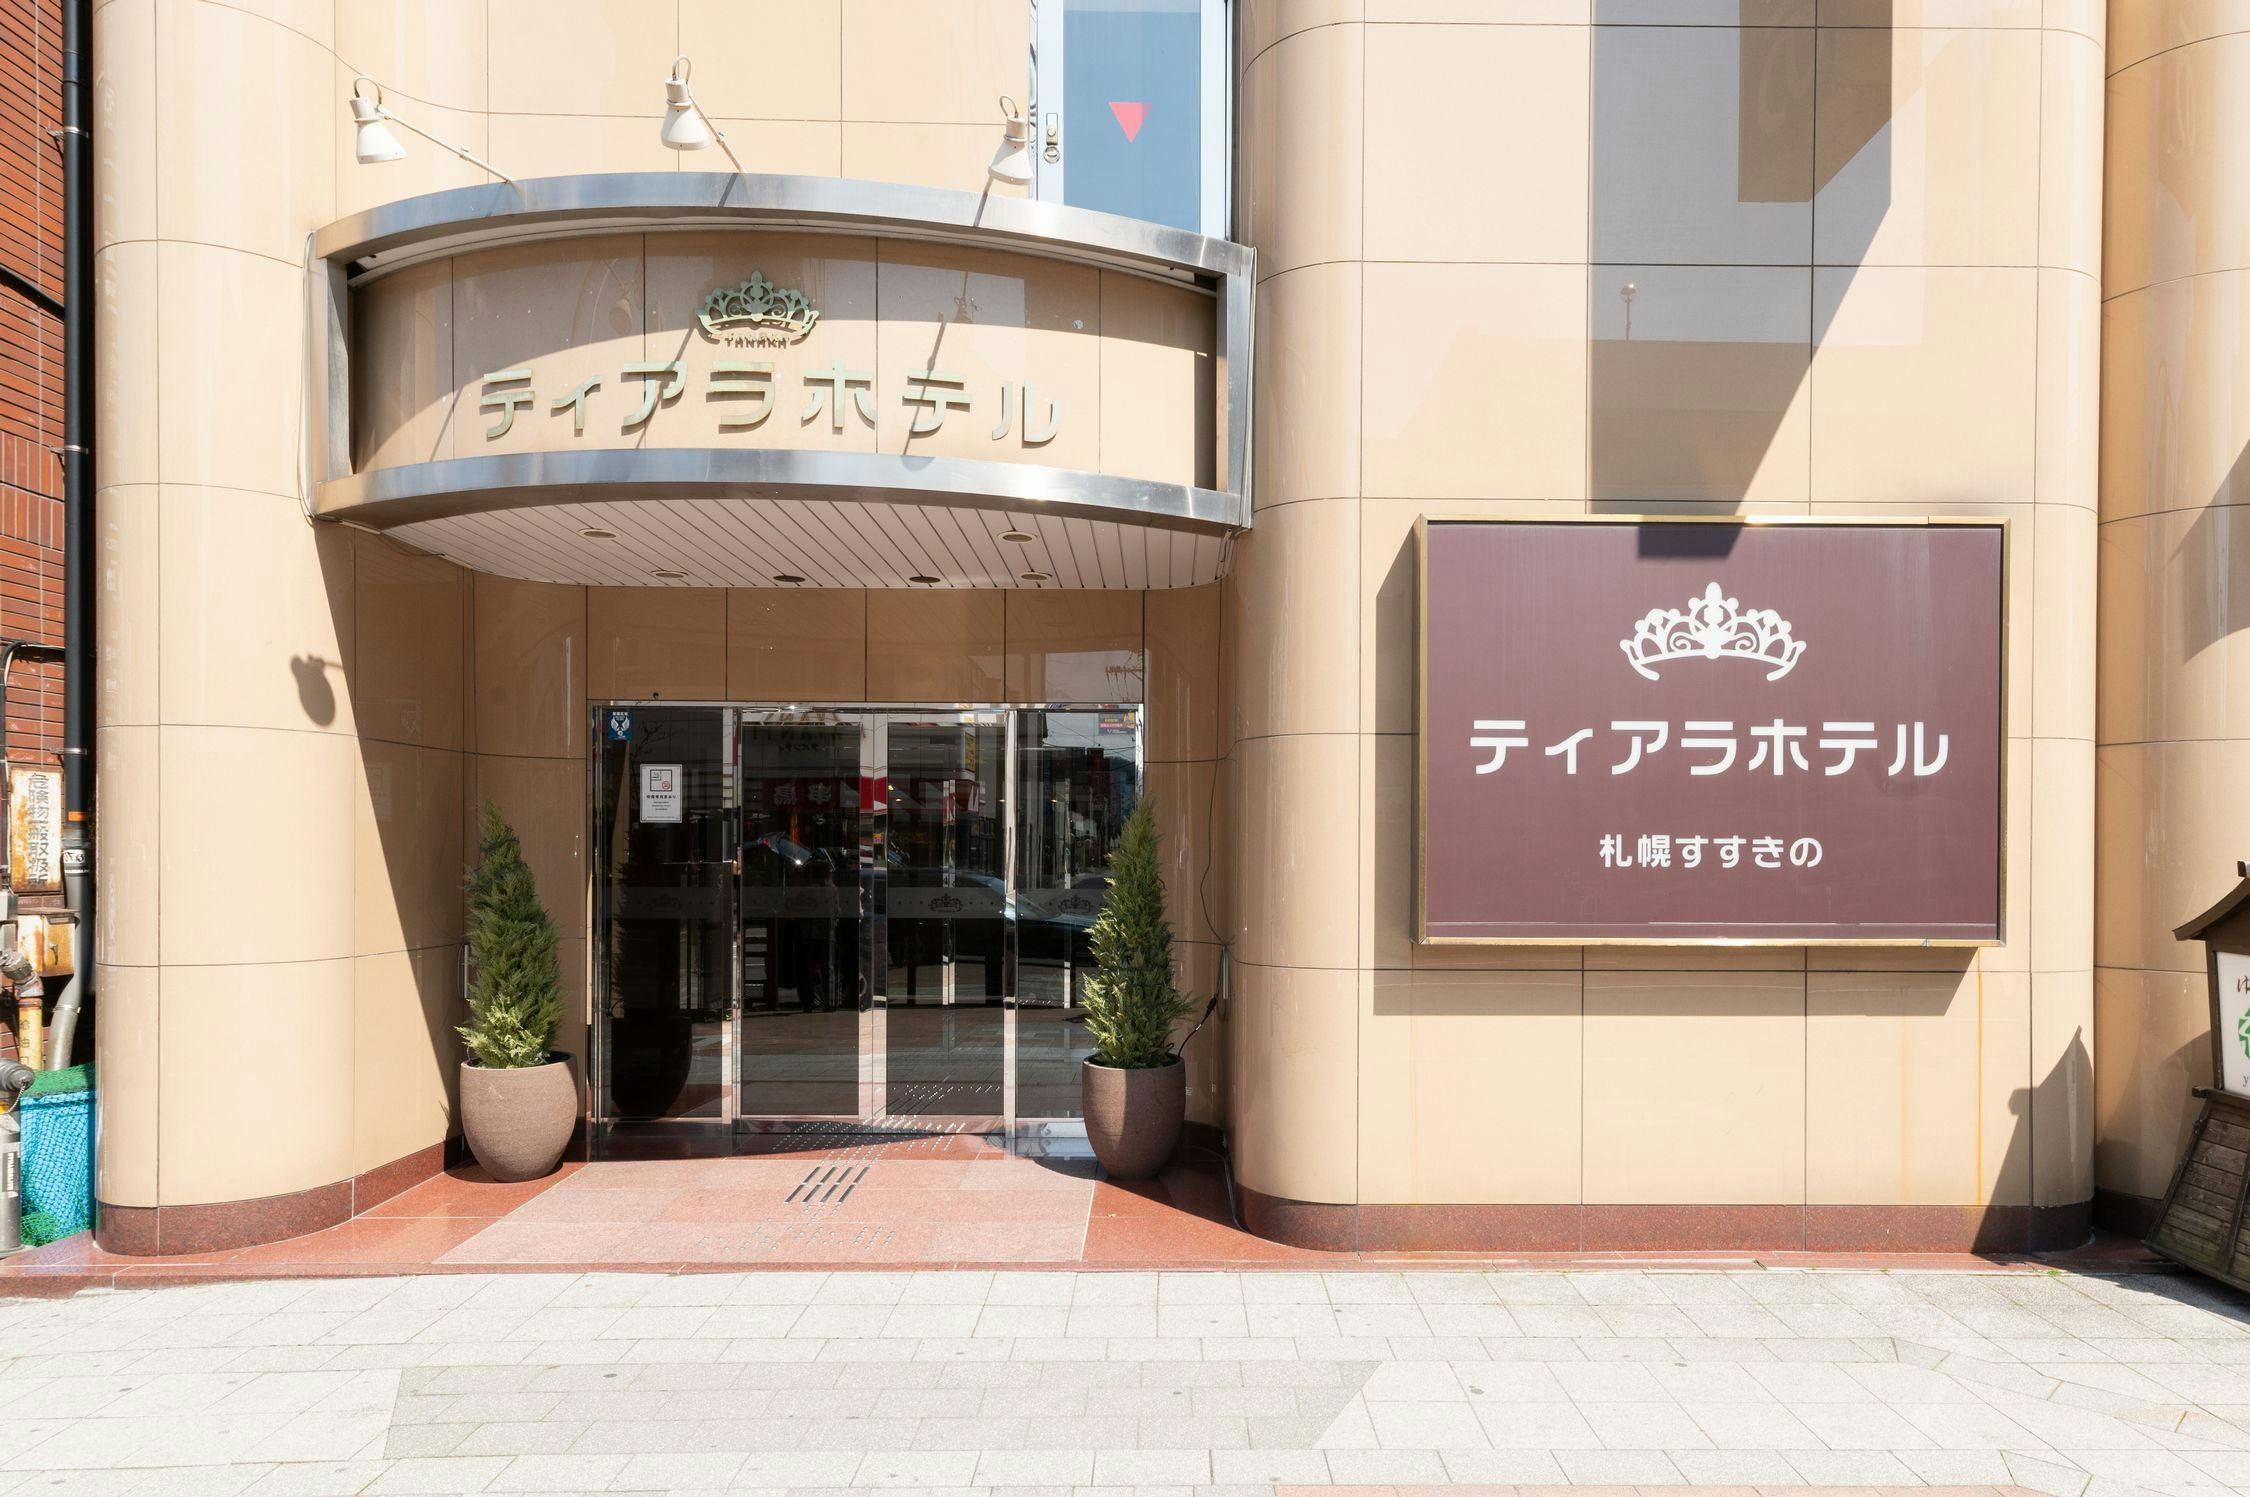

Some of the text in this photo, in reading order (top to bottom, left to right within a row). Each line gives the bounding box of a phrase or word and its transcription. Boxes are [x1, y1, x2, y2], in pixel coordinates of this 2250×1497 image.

[724, 334, 788, 349] TANAKA
[479, 358, 1064, 444] ティアラホテル
[1470, 718, 1950, 777] ティアラホテル
[1599, 834, 1824, 868] 札幌すすきの
